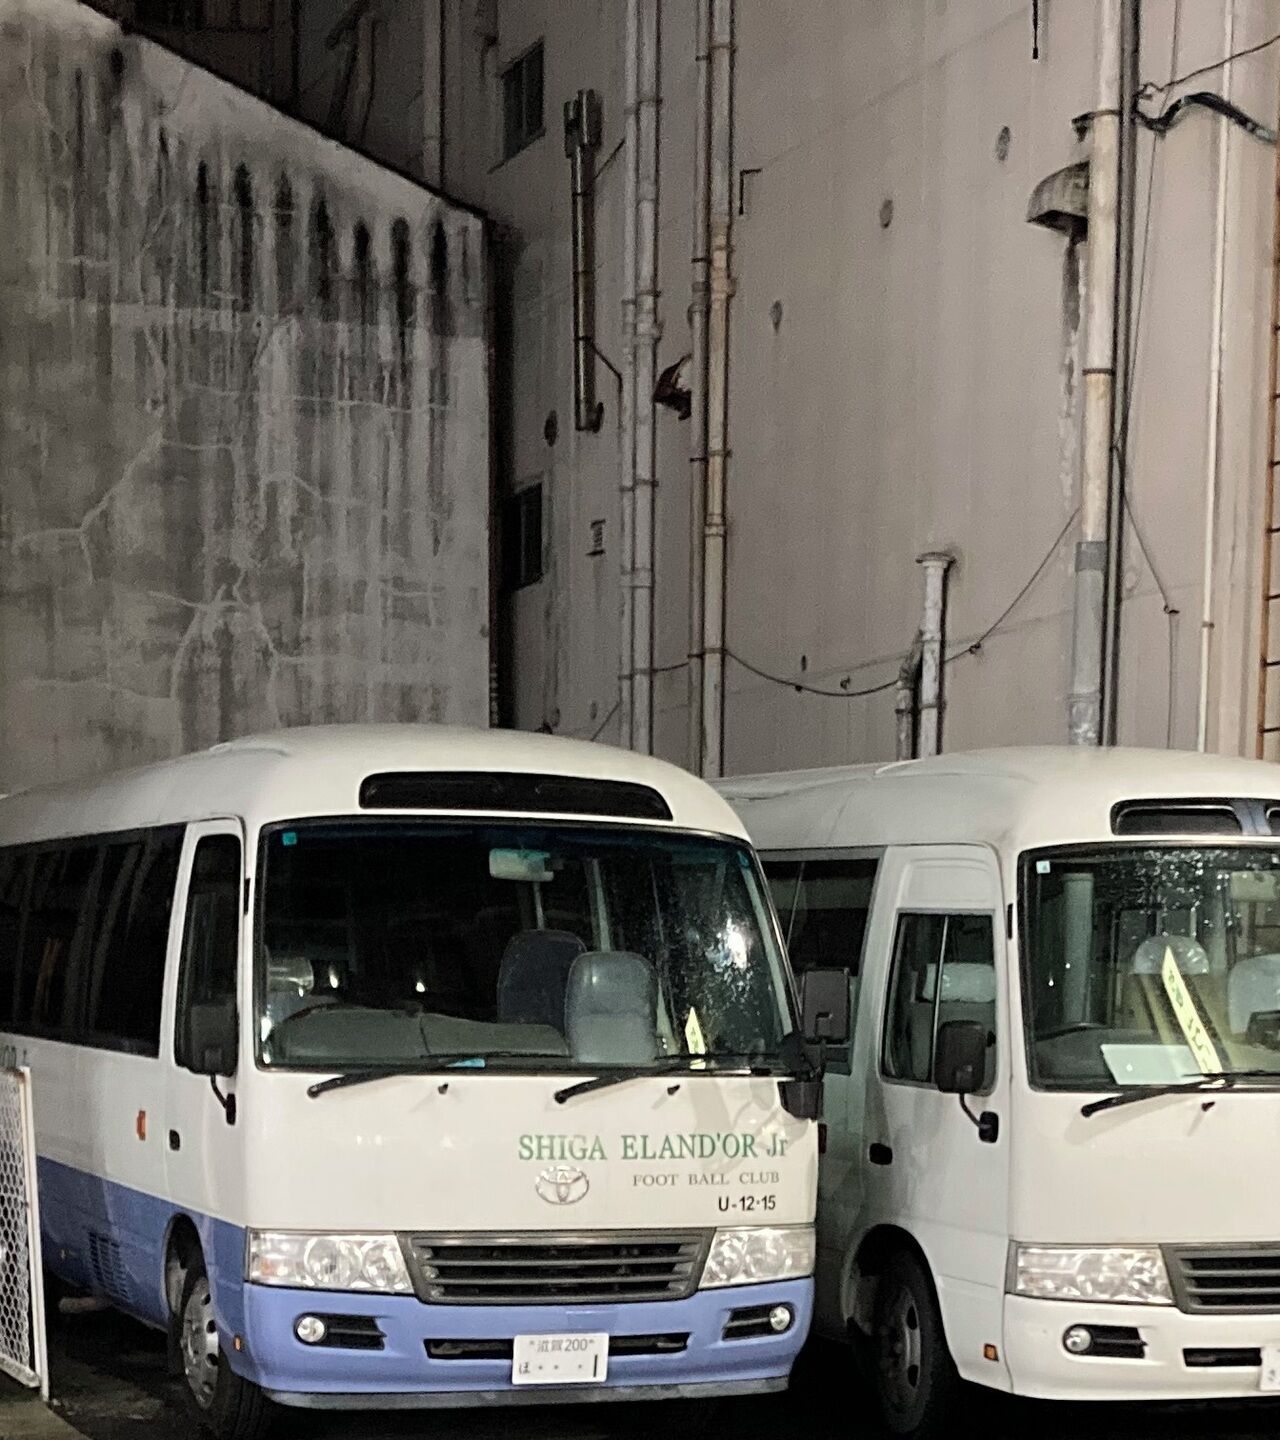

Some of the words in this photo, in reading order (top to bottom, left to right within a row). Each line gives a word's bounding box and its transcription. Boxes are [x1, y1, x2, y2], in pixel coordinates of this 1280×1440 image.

[518, 1134, 608, 1161] SHIGA
[621, 1133, 758, 1160] ELAND'OR
[766, 1132, 789, 1158] Jr
[633, 1173, 680, 1187] FOOT
[688, 1172, 730, 1186] BALL
[739, 1171, 781, 1185] CLUB
